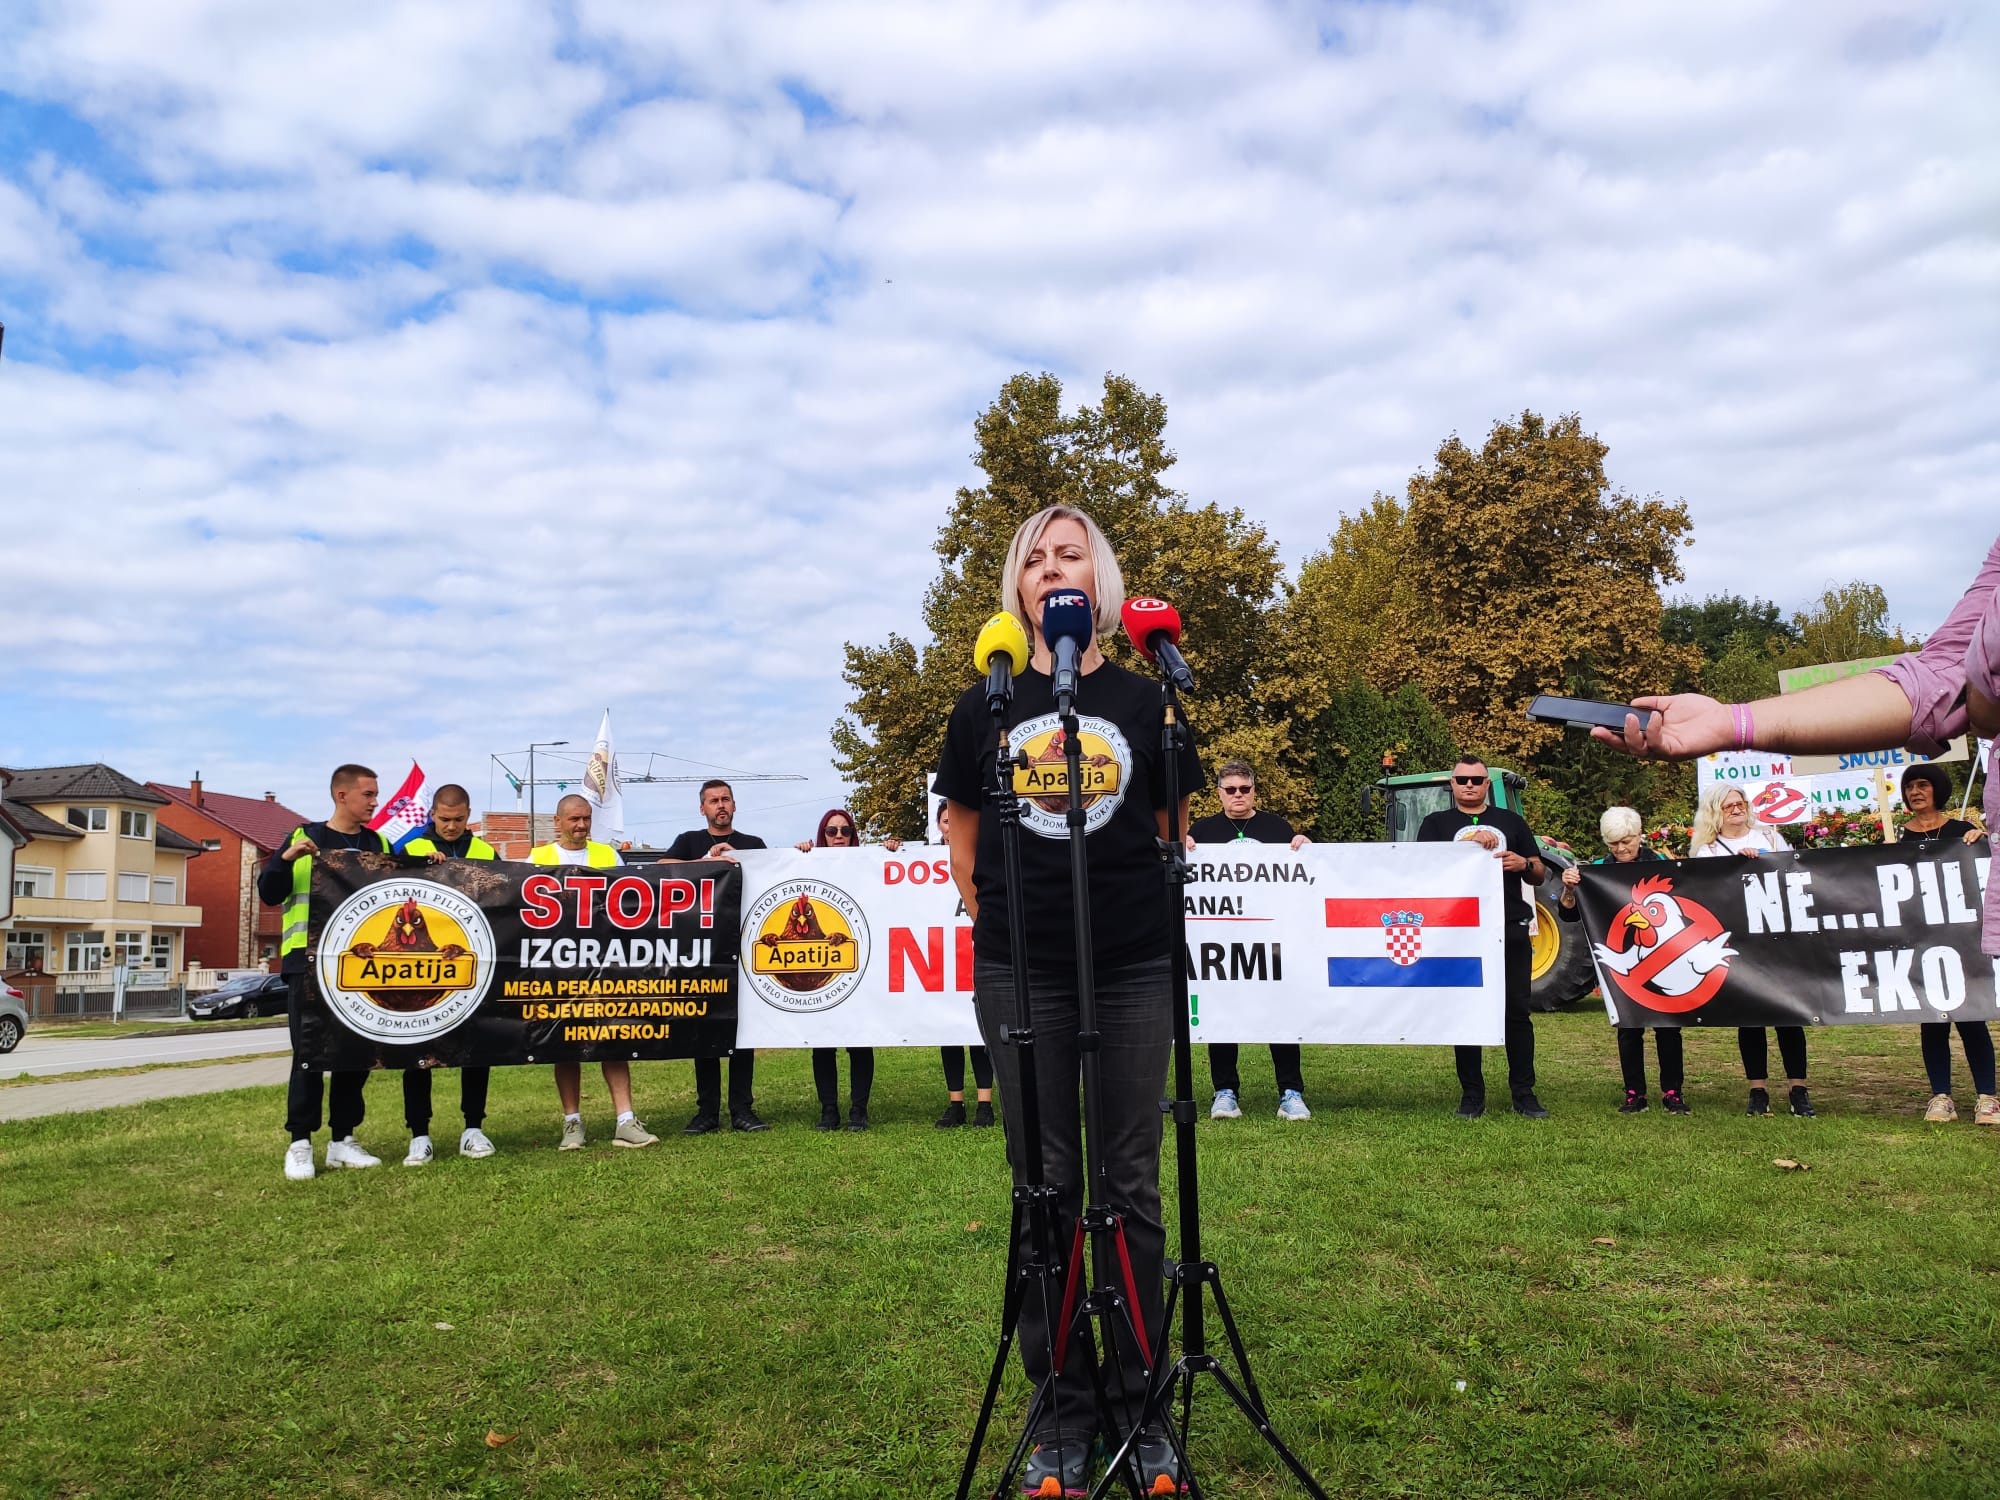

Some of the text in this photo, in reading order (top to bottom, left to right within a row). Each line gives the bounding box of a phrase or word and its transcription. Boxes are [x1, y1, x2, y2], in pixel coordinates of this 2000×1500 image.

[1011, 723, 1038, 743] STOP
[1082, 721, 1116, 739] PILIĆA
[1026, 767, 1105, 790] Apaija
[1714, 764, 1761, 780] KOJU
[1088, 803, 1110, 823] KOKA
[344, 888, 473, 924] STOP FARMI PILIĆA
[519, 874, 715, 930] STOP!
[754, 884, 854, 918] STOP FARMI PILIĆA
[520, 937, 712, 969] IZGRADNJI
[768, 945, 842, 968] Apatija
[360, 959, 457, 984] Apatija
[1840, 945, 1966, 1013] EKO
[504, 978, 729, 996] MEGA PERADARSKIH FARMI
[762, 981, 848, 1006] SELO DOMAĆIH KOKA
[350, 1001, 463, 1029] SELO DOMAĆIH KOKA
[522, 1001, 708, 1020] U SJEVEROZAPADNOJ
[564, 1024, 670, 1041] HRVATSKOJ!
